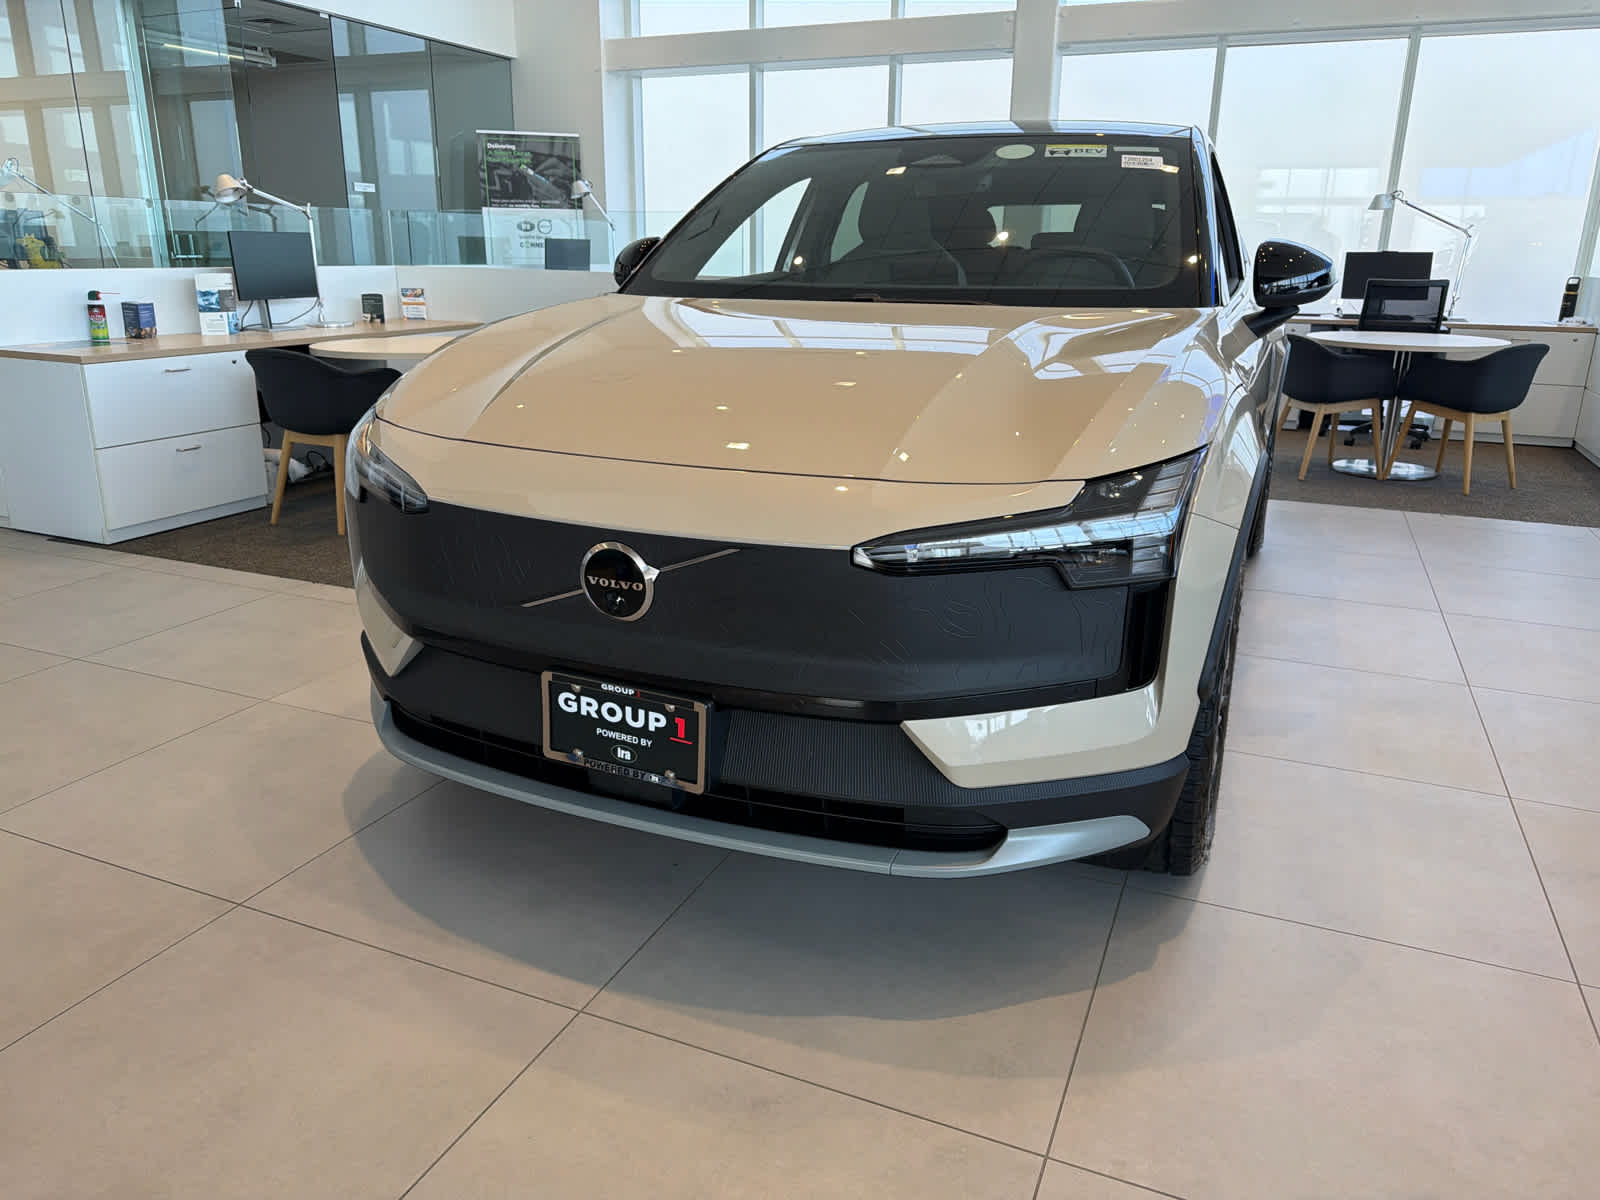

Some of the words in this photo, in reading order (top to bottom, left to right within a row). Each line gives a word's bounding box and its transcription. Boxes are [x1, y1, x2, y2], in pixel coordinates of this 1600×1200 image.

[586, 575, 644, 592] VOLVO
[600, 683, 635, 696] GROUP
[557, 691, 667, 732] GROUP
[673, 716, 688, 741] 1
[596, 727, 639, 744] POWERED
[640, 737, 653, 748] BY
